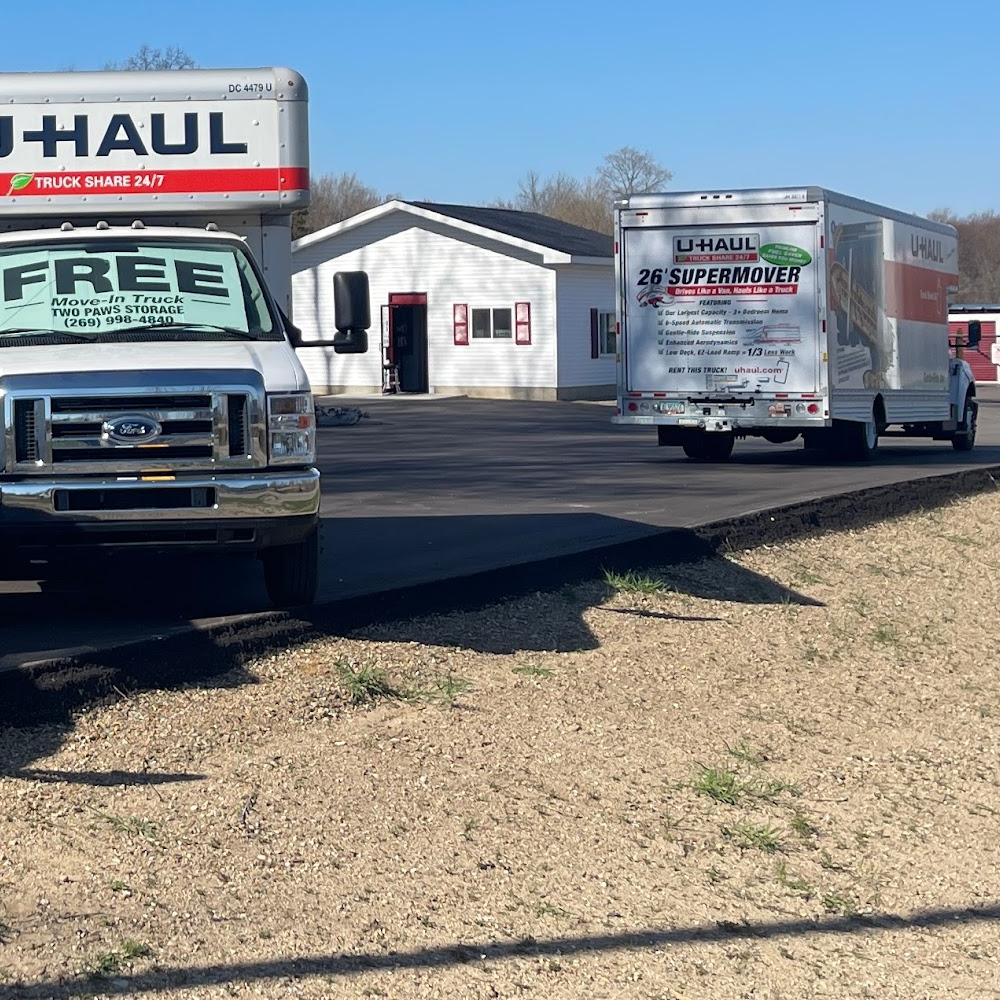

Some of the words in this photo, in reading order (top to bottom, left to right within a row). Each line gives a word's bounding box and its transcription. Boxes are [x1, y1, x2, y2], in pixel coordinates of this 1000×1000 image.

[228, 83, 242, 93] DC
[243, 83, 264, 92] 4479
[265, 82, 273, 92] U
[34, 175, 80, 190] TRUCK
[84, 174, 132, 189] SHARE
[134, 174, 166, 188] 24/7
[677, 236, 756, 253] U-HAUL
[911, 234, 945, 264] U-HAUL
[688, 254, 710, 262] TRUCK
[3, 255, 230, 302] FREE
[668, 266, 801, 285] SUPERMOVER
[675, 287, 696, 295] Drives
[697, 287, 711, 295] Like
[753, 286, 767, 294] Like
[51, 294, 125, 307] Move-In
[137, 294, 185, 305] Truck
[51, 307, 80, 317] TWO
[84, 304, 121, 317] PAWS
[125, 304, 185, 315] STORAGE
[64, 317, 101, 328] (269)
[106, 315, 174, 326] 998-4840
[748, 347, 763, 357] 1/3
[668, 366, 686, 374] RENT
[686, 366, 702, 374] THIS
[734, 366, 782, 374] uhaul.com
[119, 421, 147, 436] Ford
